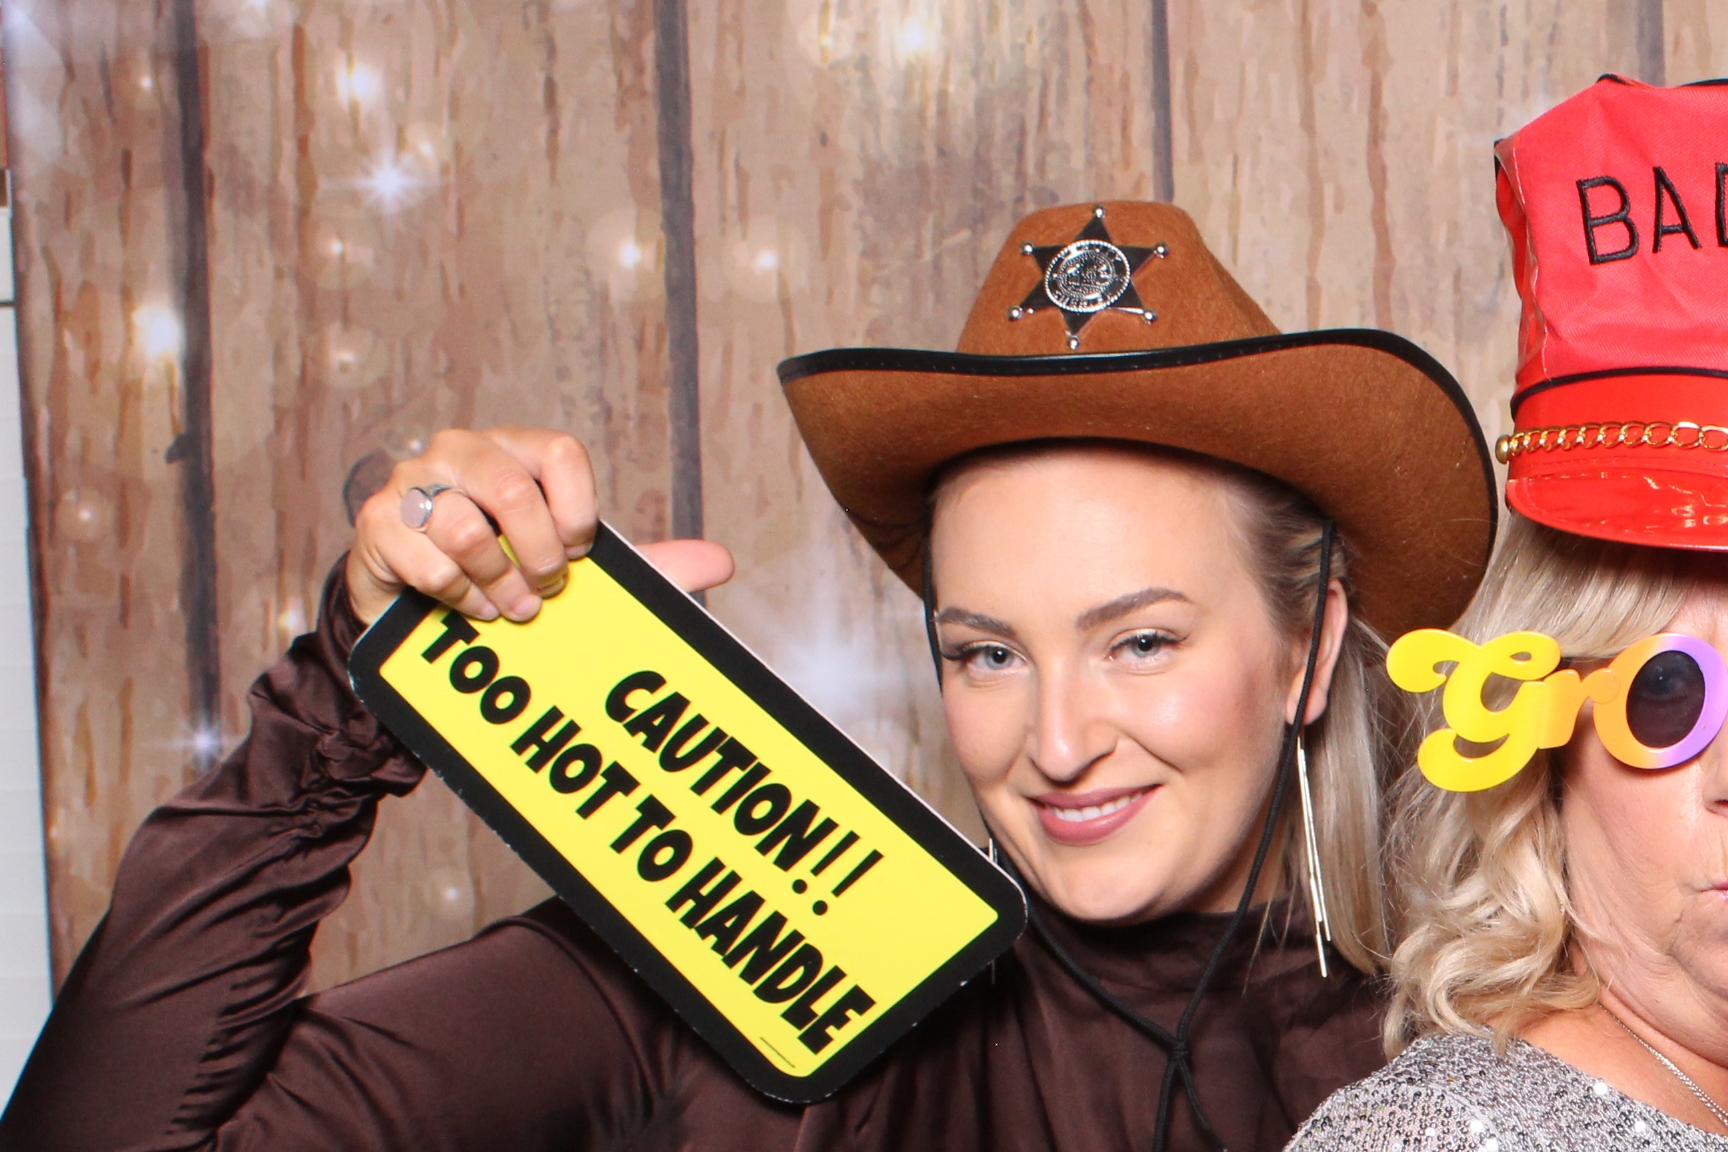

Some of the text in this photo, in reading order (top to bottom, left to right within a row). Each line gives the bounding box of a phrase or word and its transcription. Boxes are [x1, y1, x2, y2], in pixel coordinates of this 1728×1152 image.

[420, 609, 877, 1055] TOO HOT TO HANDLE
[604, 670, 884, 916] CAUTION!!
